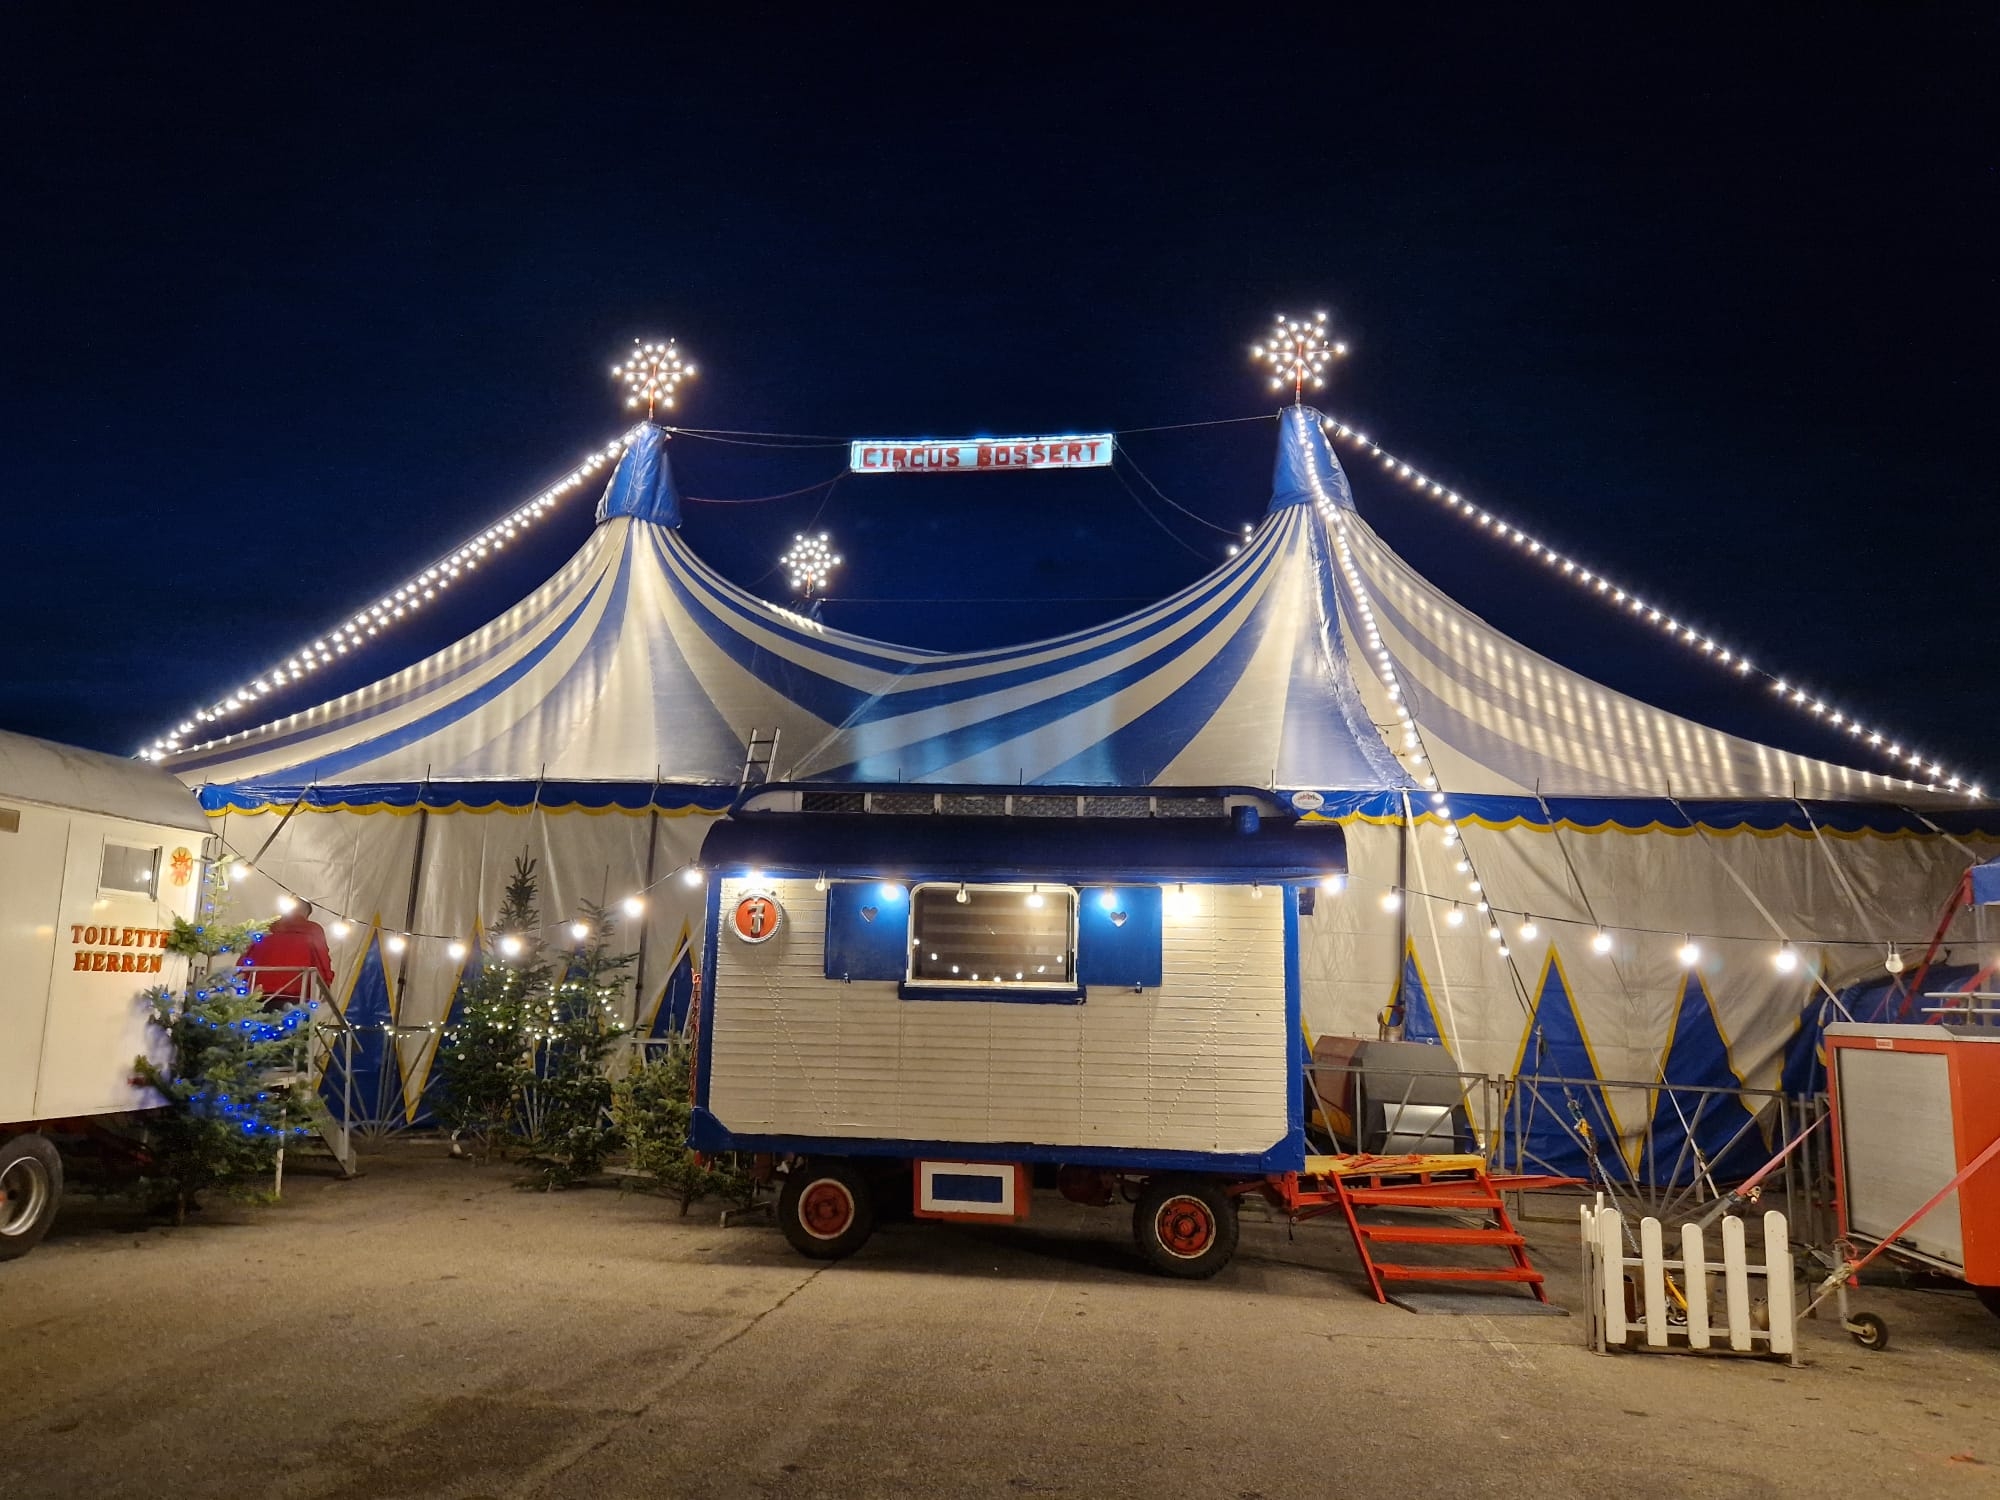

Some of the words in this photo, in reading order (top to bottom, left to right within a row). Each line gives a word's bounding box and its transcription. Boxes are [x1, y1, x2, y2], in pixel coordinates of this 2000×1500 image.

[863, 447, 959, 468] CIRCUS
[977, 442, 1101, 467] BOSSERT
[73, 951, 163, 973] HERREN
